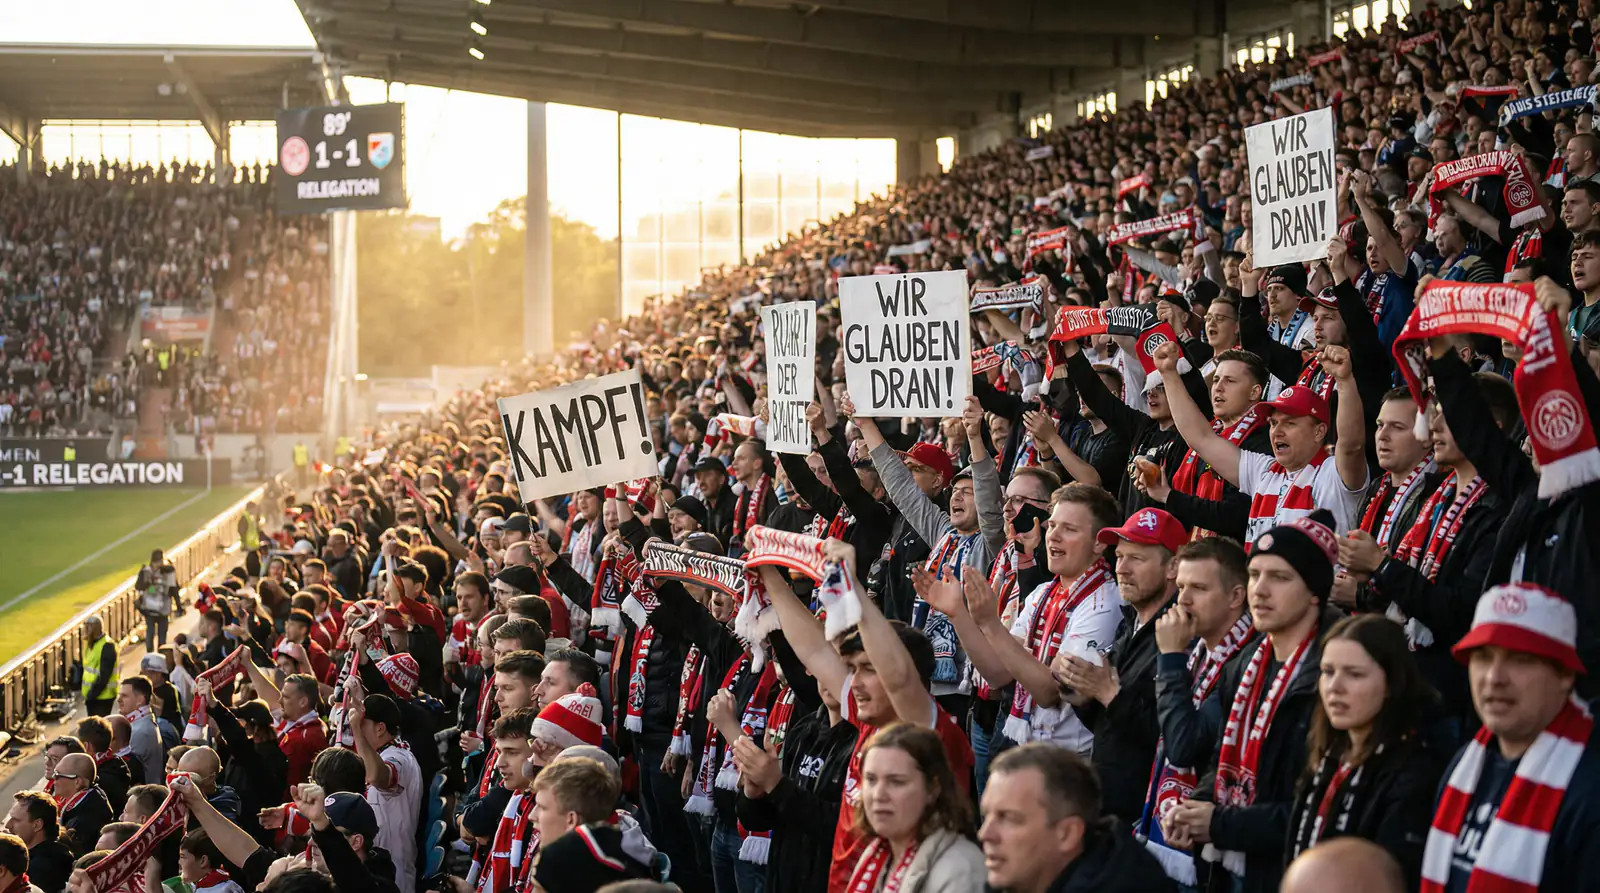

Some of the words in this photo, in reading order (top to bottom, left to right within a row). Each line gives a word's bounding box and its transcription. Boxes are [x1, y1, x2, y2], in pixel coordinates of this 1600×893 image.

[323, 112, 351, 136] 89'
[1271, 115, 1308, 156] WIR
[297, 178, 380, 199] RELEGATION
[1255, 149, 1333, 206] GLAUBEN
[1270, 200, 1326, 250] DRAN!
[845, 320, 960, 364] GLAUBEN
[777, 363, 798, 395] DER
[870, 366, 954, 409] DRAN!
[502, 382, 653, 482] KAMPF!
[33, 462, 183, 484] RELEGATION
